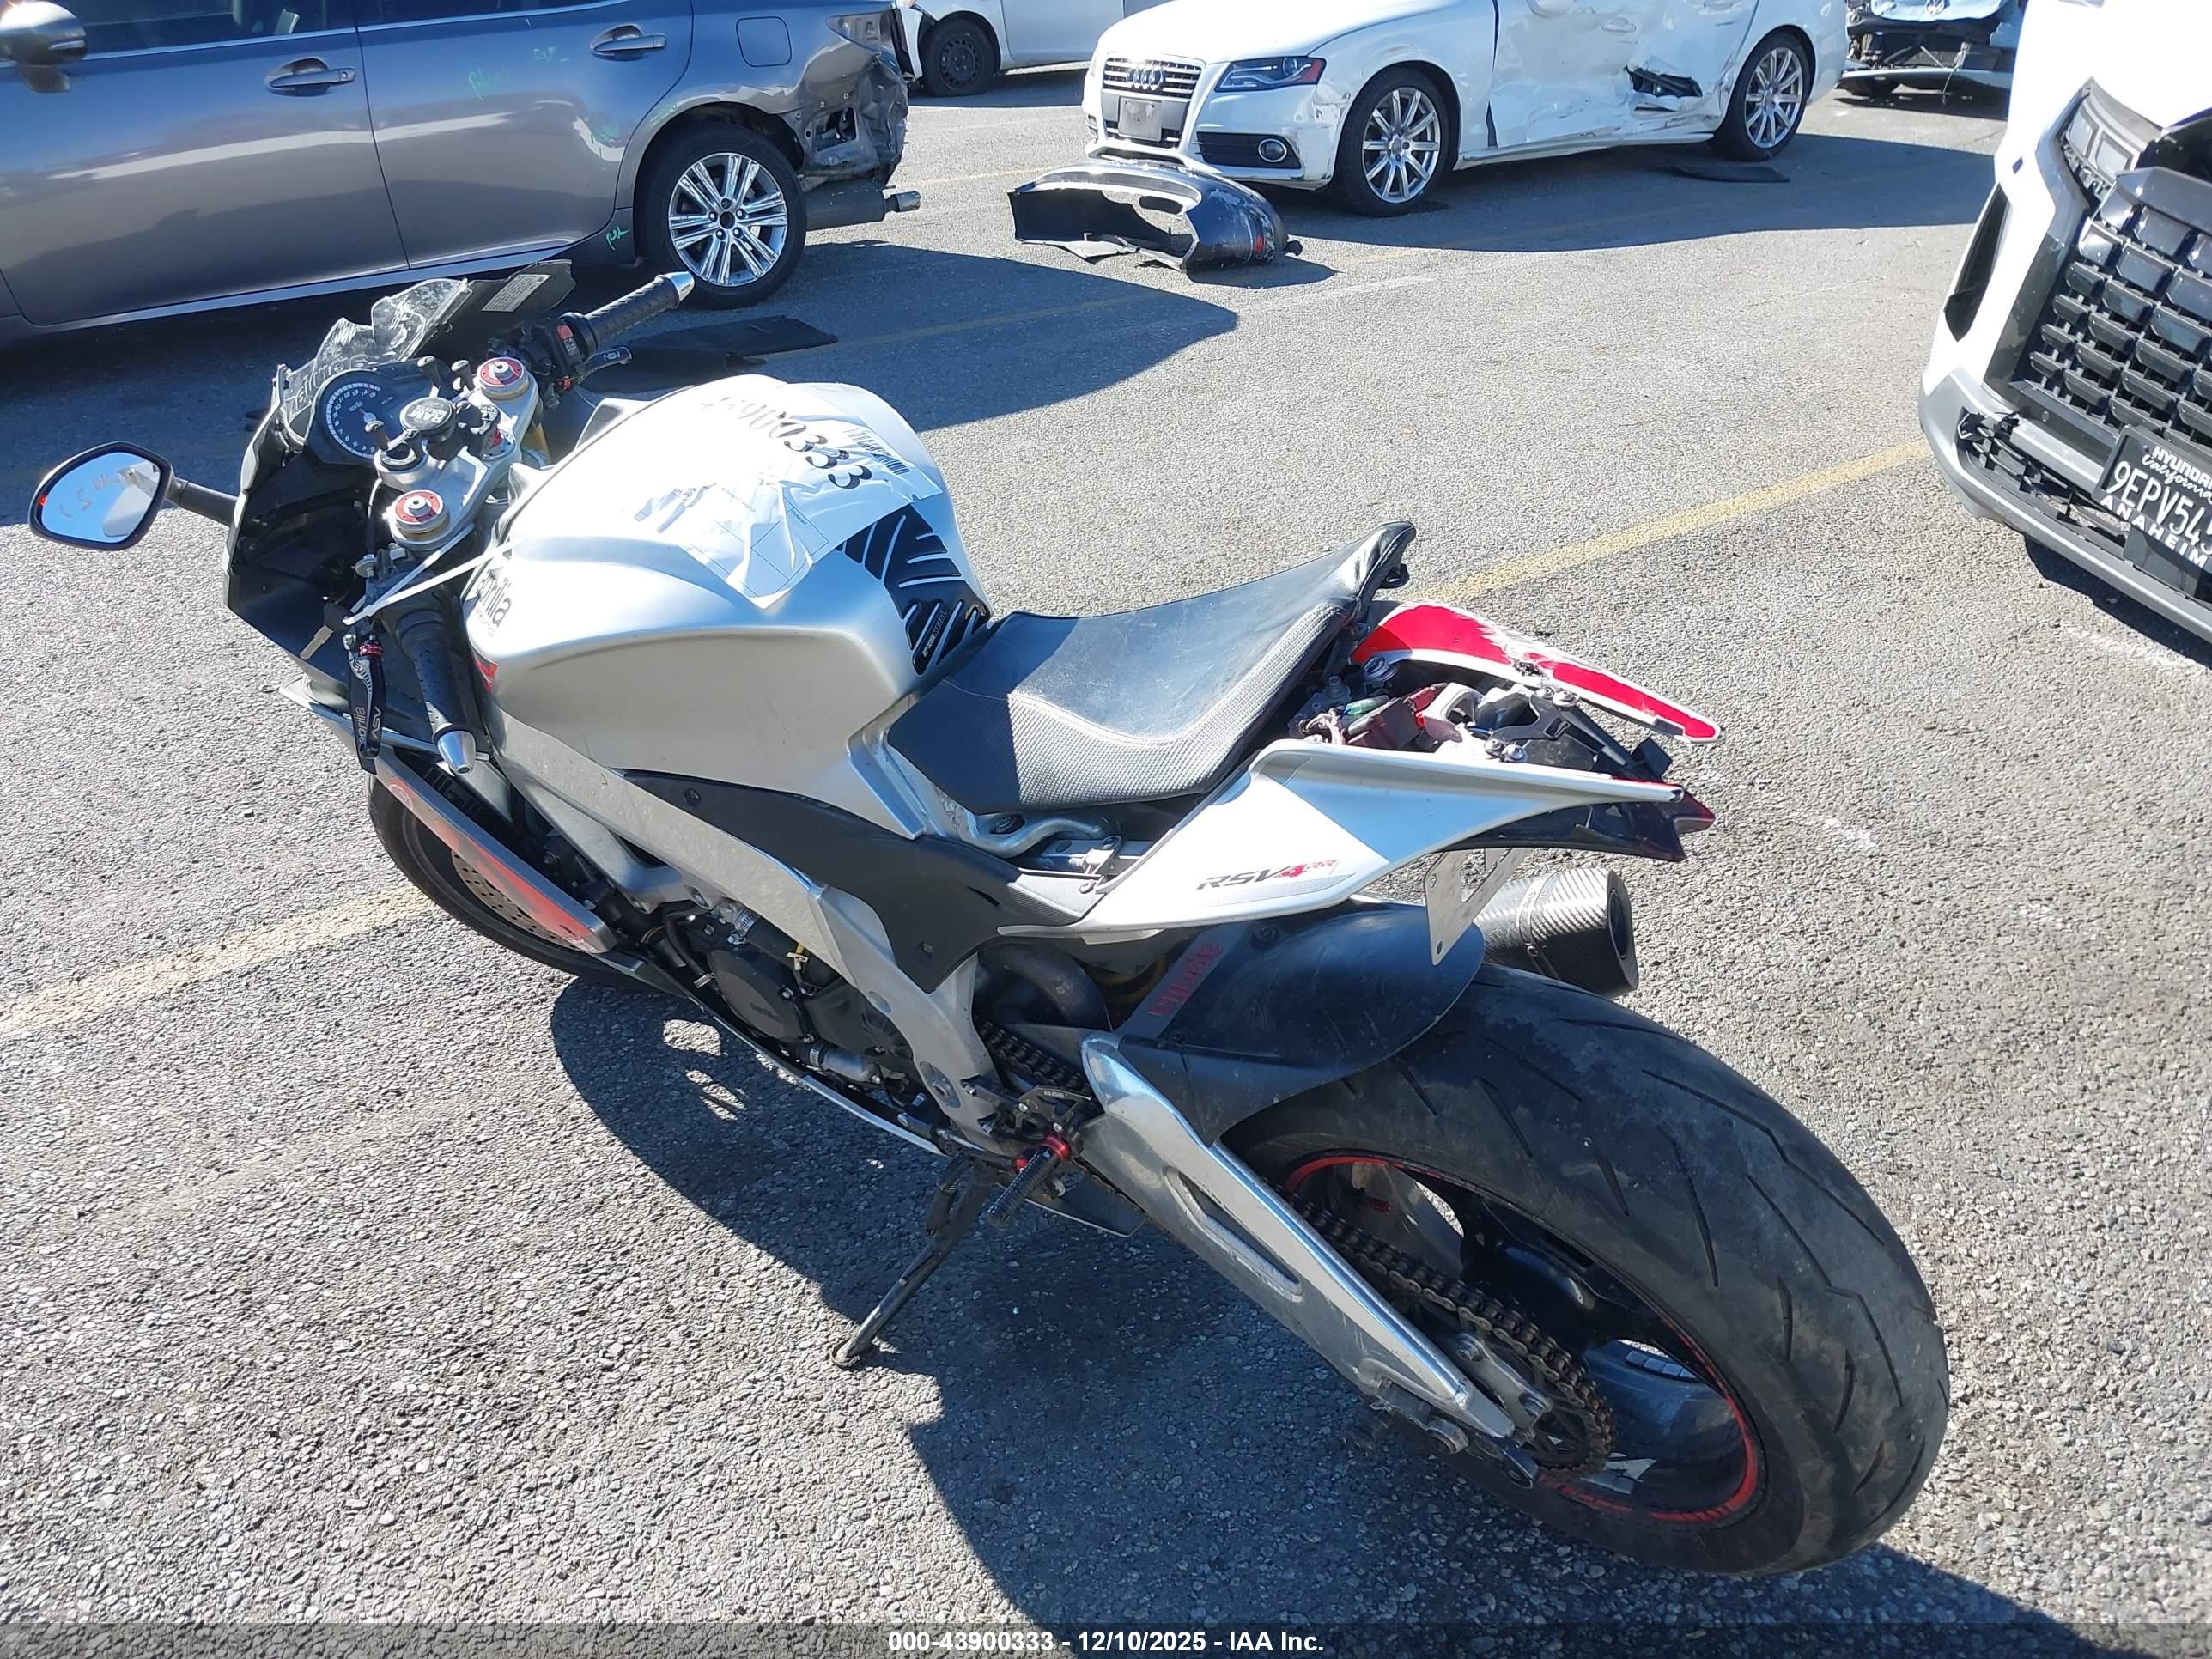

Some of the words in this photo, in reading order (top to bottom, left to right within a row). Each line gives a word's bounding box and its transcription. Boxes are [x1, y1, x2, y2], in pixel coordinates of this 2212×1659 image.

[409, 409, 448, 424] RAM
[2100, 495, 2208, 568] ANAHEIM
[476, 576, 513, 628] aprilia
[370, 706, 382, 739] ASV
